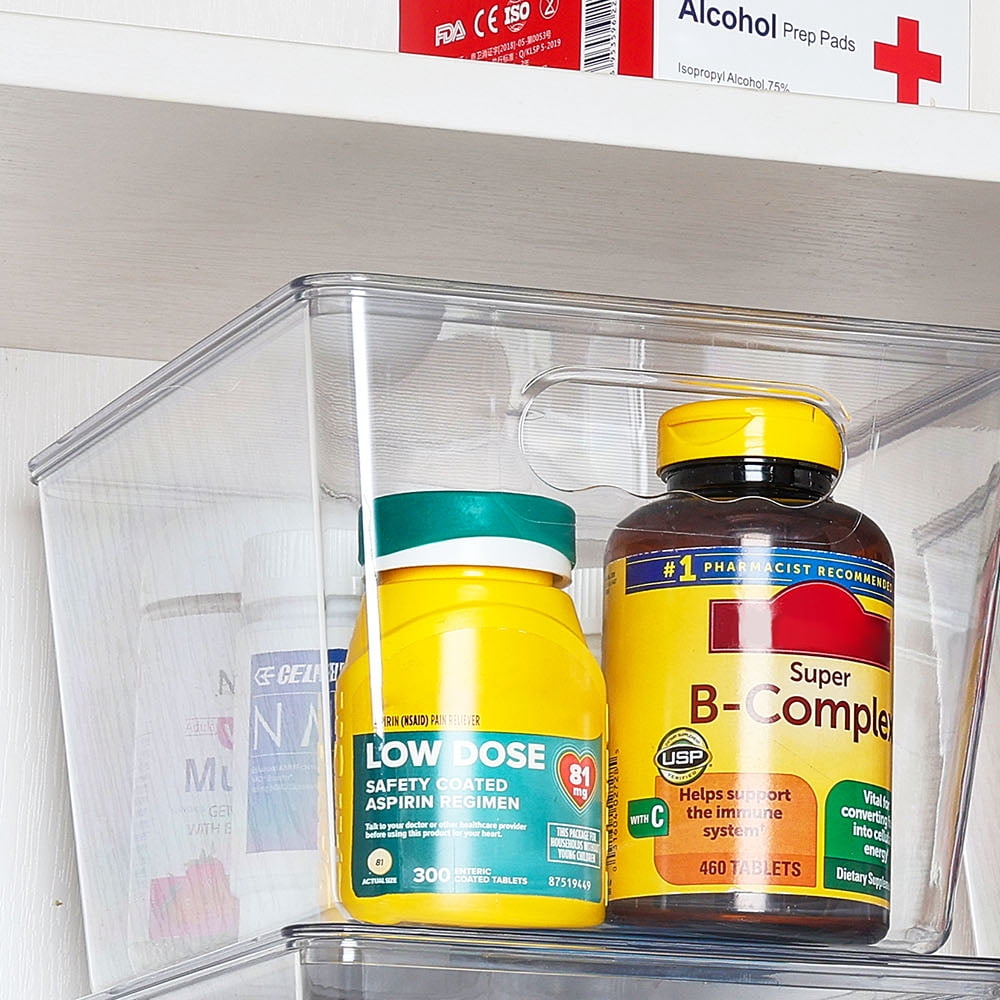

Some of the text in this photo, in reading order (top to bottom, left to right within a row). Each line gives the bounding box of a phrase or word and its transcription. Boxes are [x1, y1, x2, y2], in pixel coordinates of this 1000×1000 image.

[434, 19, 466, 47] FDA
[473, 5, 499, 38] CE
[503, 1, 530, 26] ISO
[678, 0, 856, 52] Alcohol Prep Pads
[678, 61, 726, 84] Isopropyl
[662, 554, 697, 582] #1
[703, 560, 812, 576] PHARMACIST
[789, 661, 851, 688] Super
[400, 714, 429, 728] (NSAID)
[366, 740, 546, 771] LOW DOSE
[662, 750, 704, 766] USP
[569, 764, 591, 787] 81
[365, 777, 508, 794] SAFETY COATED
[572, 787, 588, 800] mg
[365, 794, 520, 811] ASPIRIN REGIMEN
[679, 787, 792, 804] Helps support
[863, 789, 882, 808] Vital
[629, 804, 665, 829] WITH C
[686, 805, 783, 819] the immune
[852, 821, 873, 839] into
[412, 867, 492, 883] 300 ENTERIC
[699, 860, 802, 877] 460 TABLETS
[836, 866, 868, 887] Dietary
[454, 875, 528, 886] COATED TABLETS
[548, 876, 592, 890] 87519449
